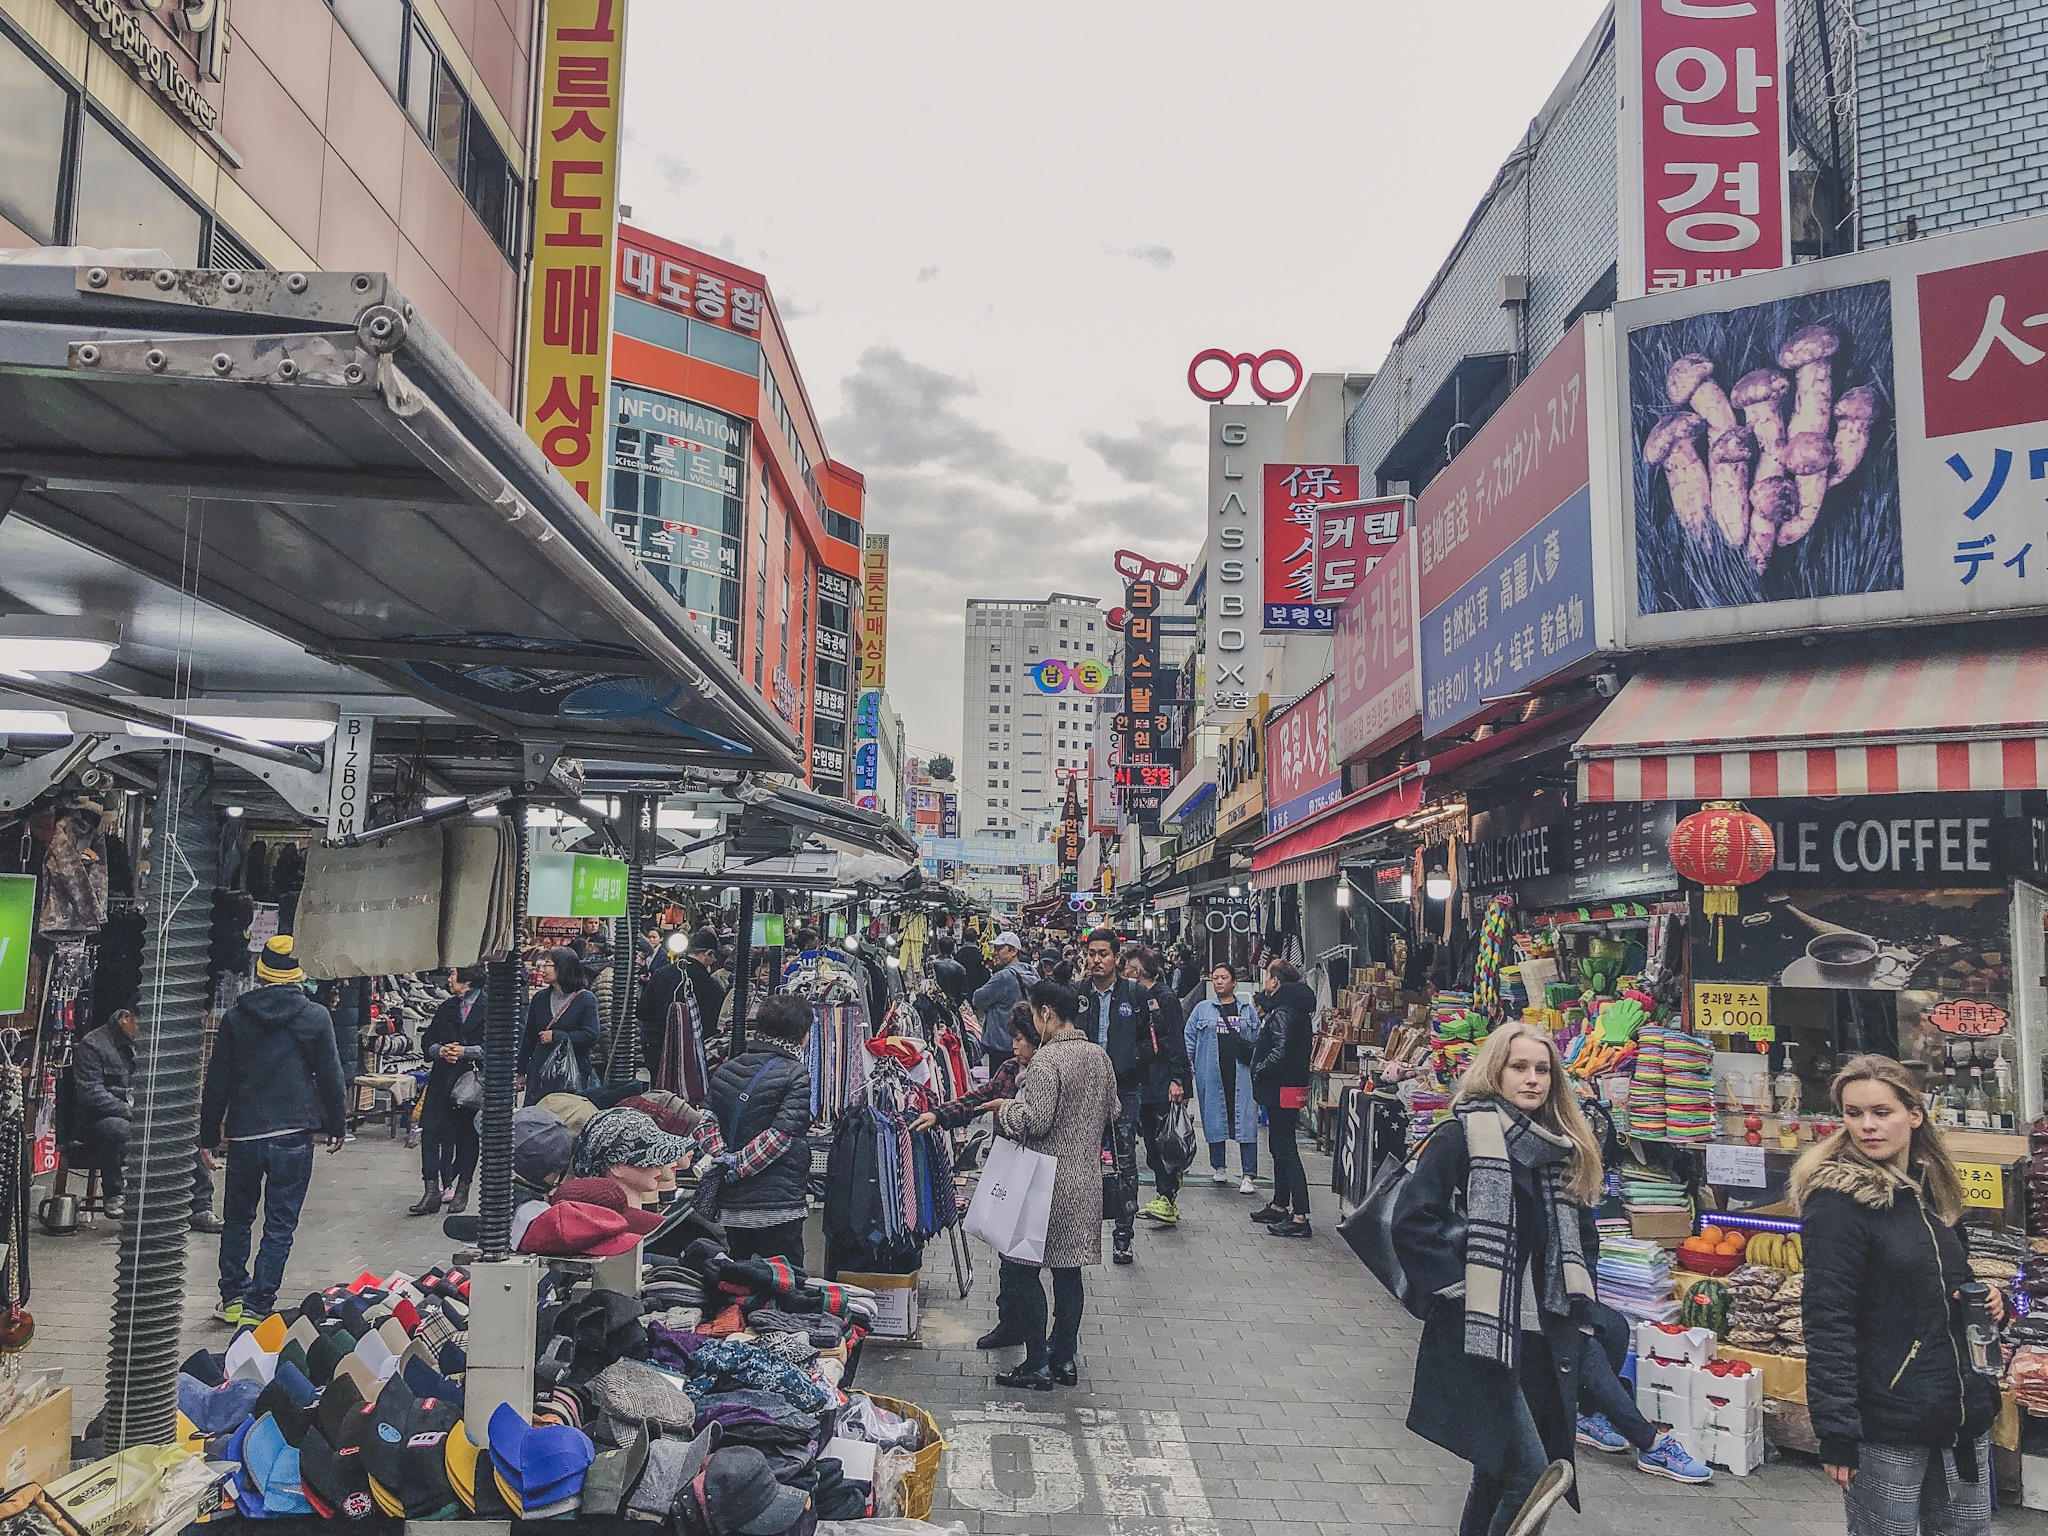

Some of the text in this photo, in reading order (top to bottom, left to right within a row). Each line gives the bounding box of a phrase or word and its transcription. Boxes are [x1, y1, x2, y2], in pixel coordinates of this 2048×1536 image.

[165, 51, 217, 131] Tower
[535, 0, 614, 506] 그릇도매상
[623, 248, 764, 331] 대도종합
[618, 396, 739, 448] INFORMATION
[1475, 413, 1541, 525] ディスカウント
[1547, 373, 1580, 453] ストア
[615, 456, 737, 495] Kitchenware Wholesale
[684, 556, 736, 577] Folkcraft
[865, 553, 887, 684] 그릇도매상가
[1131, 584, 1152, 713] 크리스탈
[1473, 642, 1505, 695] キムチ
[337, 719, 361, 834] BIZBOOM
[1505, 825, 1550, 882] COFFEE
[1832, 817, 1991, 873] COFFEE
[1701, 1008, 1763, 1026] 3.000
[1737, 992, 1761, 1007] 주스
[1939, 1005, 1997, 1022] 中国话
